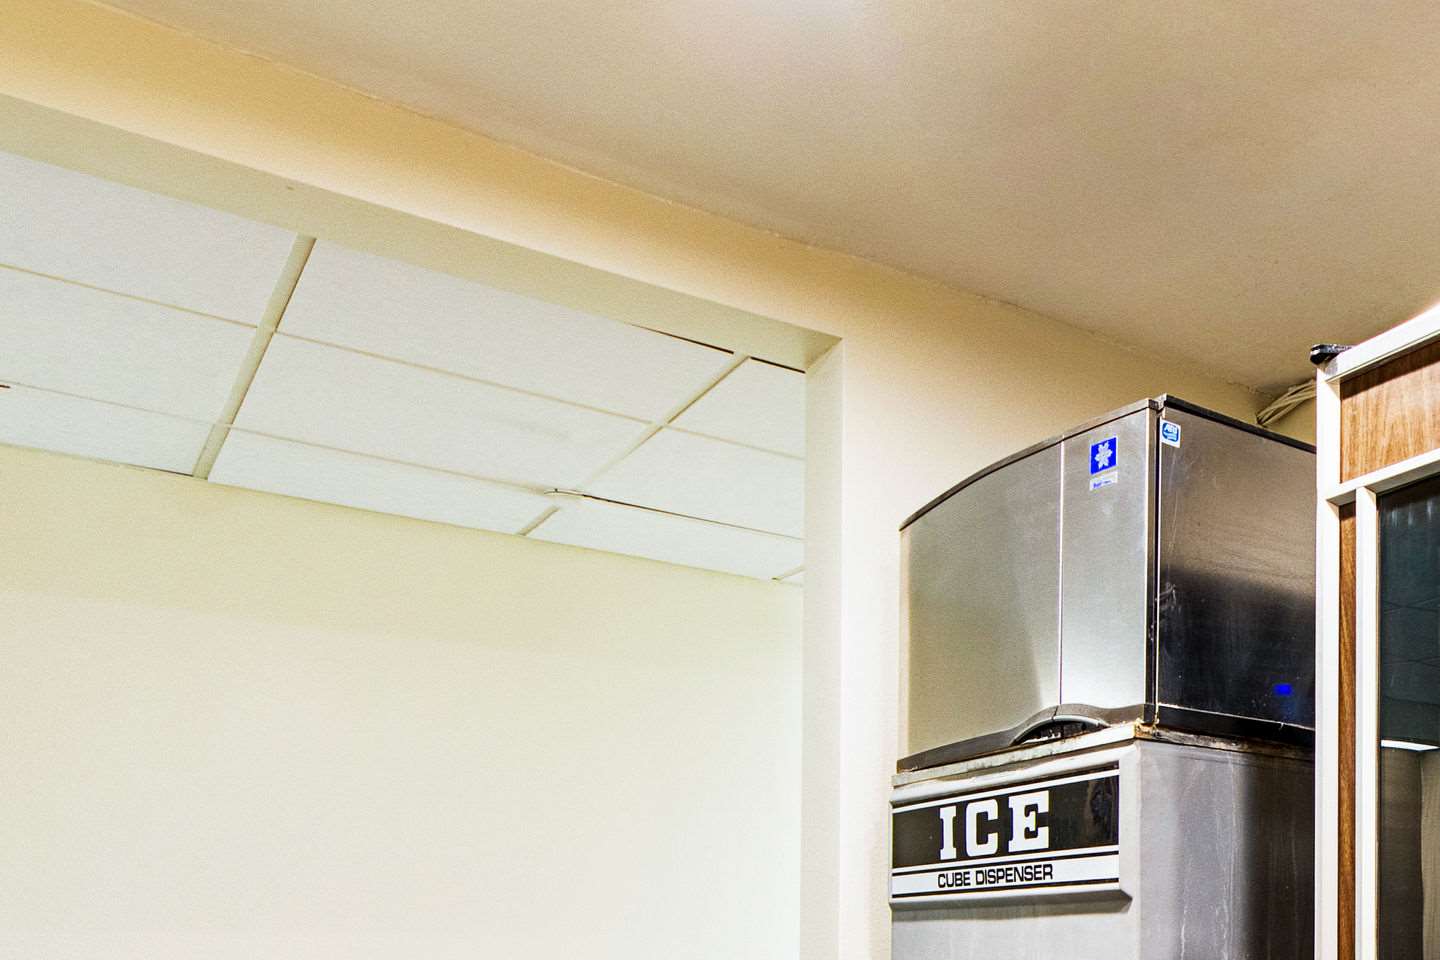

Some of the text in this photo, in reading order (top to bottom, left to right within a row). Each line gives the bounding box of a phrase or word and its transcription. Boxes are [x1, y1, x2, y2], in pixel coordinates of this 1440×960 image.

[940, 790, 1049, 860] ICE
[938, 864, 1053, 888] CUBE DISPENSER
